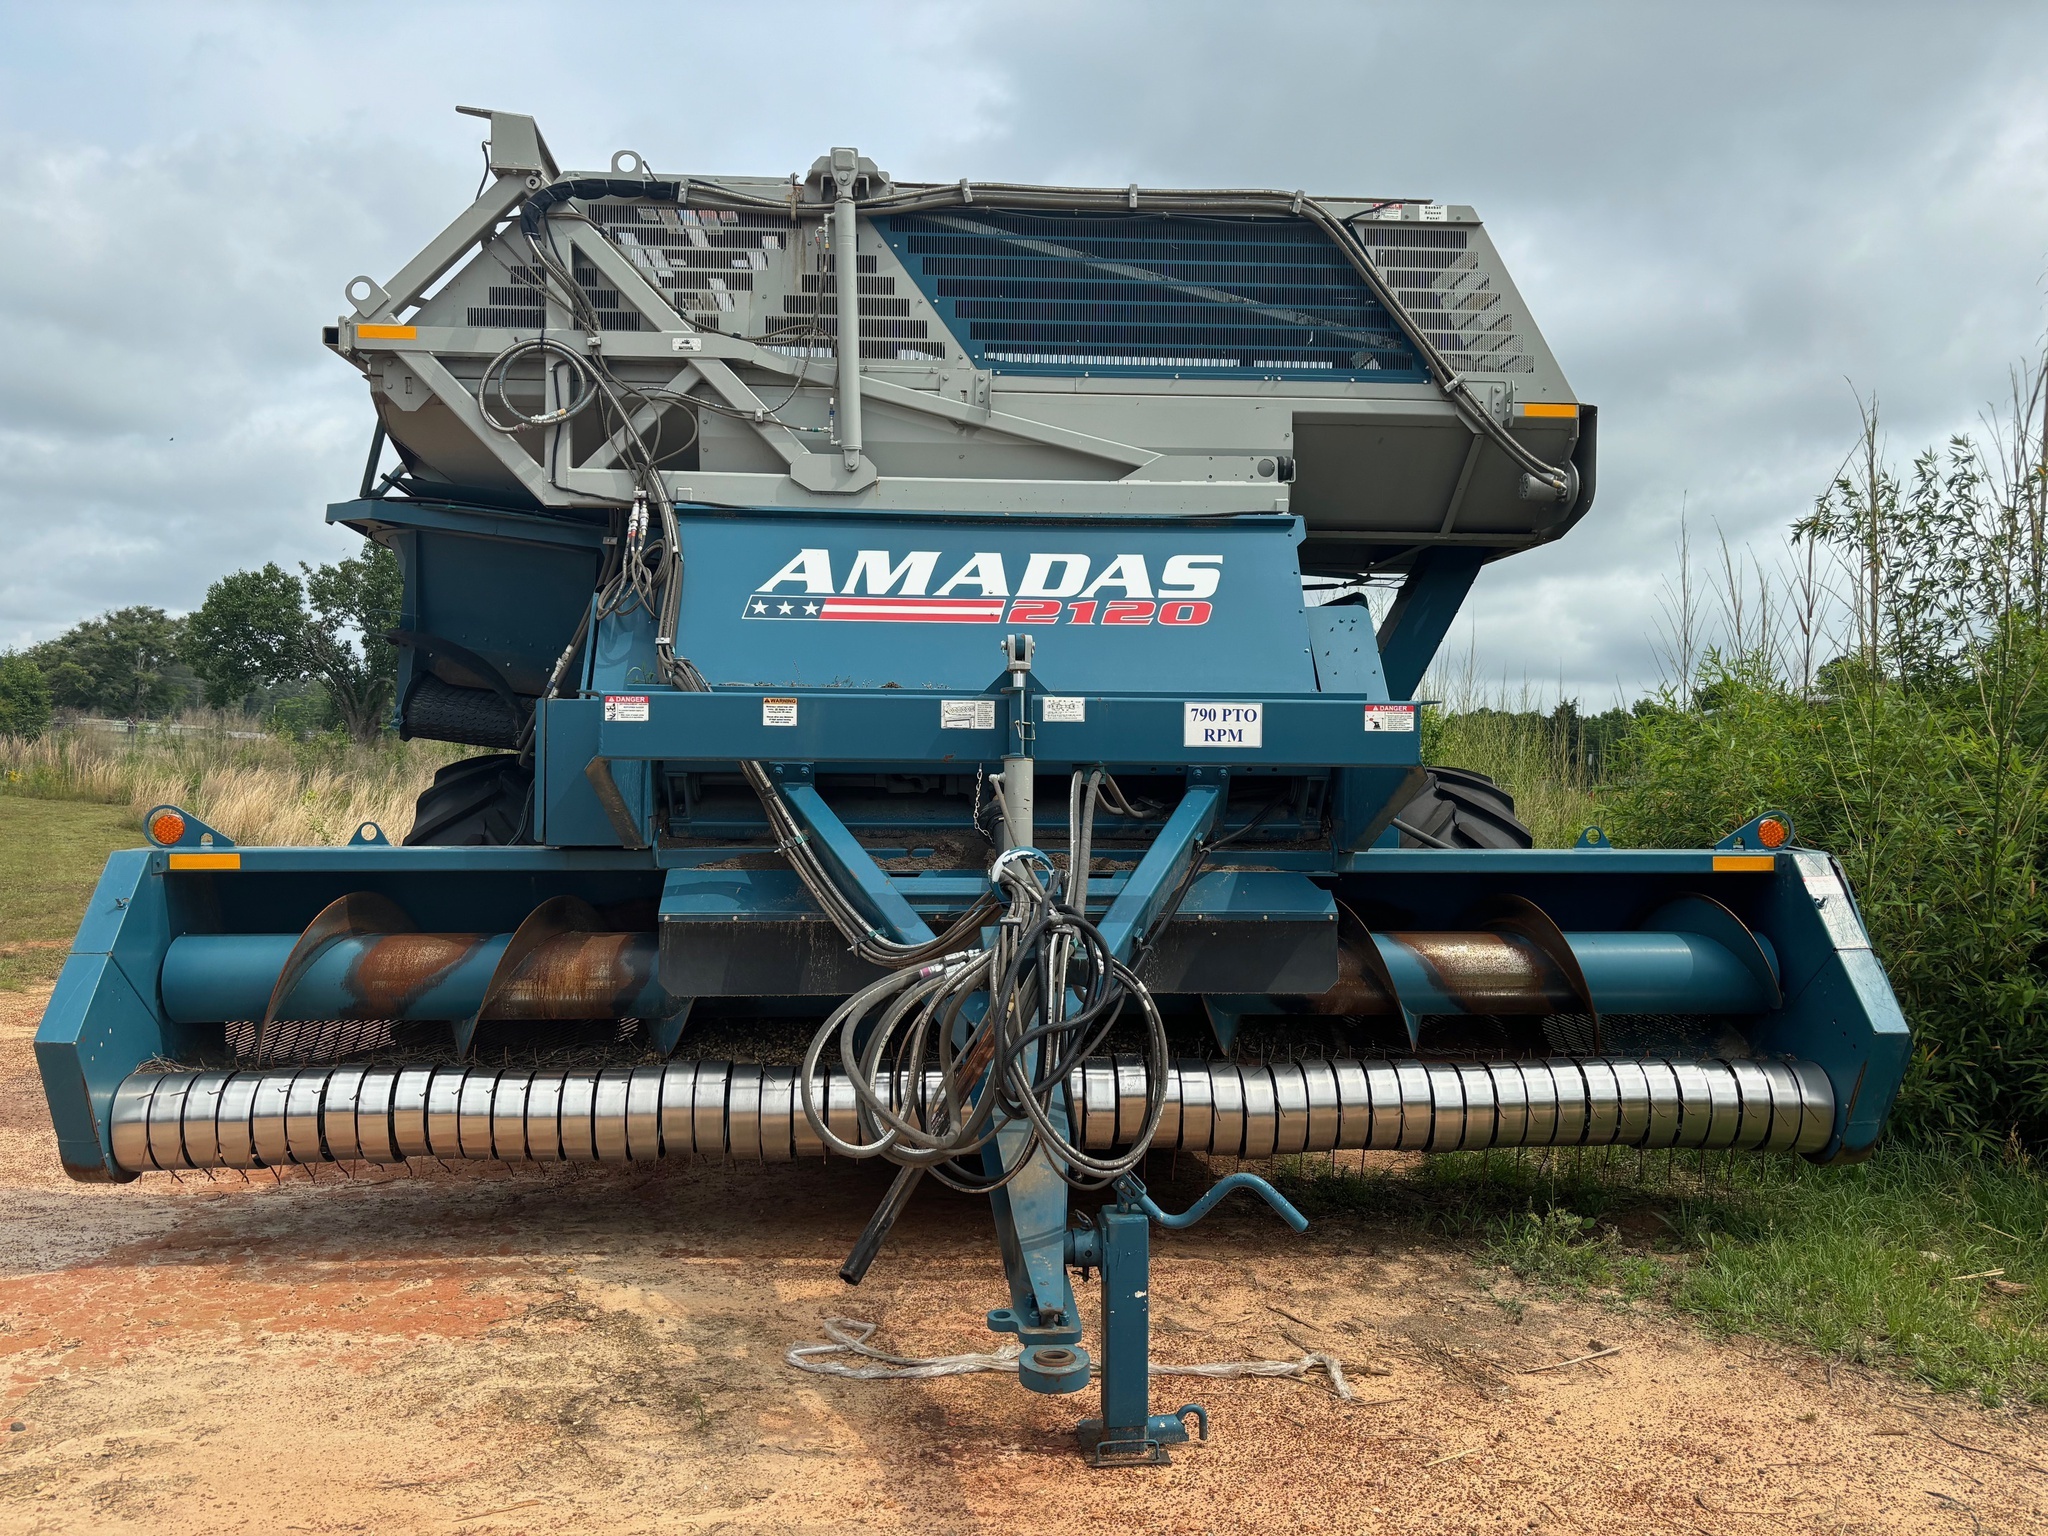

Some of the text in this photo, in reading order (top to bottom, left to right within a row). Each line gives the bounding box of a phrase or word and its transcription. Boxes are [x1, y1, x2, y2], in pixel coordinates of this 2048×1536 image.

[754, 548, 1224, 599] AMADAS
[1005, 599, 1214, 627] 2120
[1190, 708, 1258, 724] 790 PTO
[1203, 728, 1244, 743] RPM
